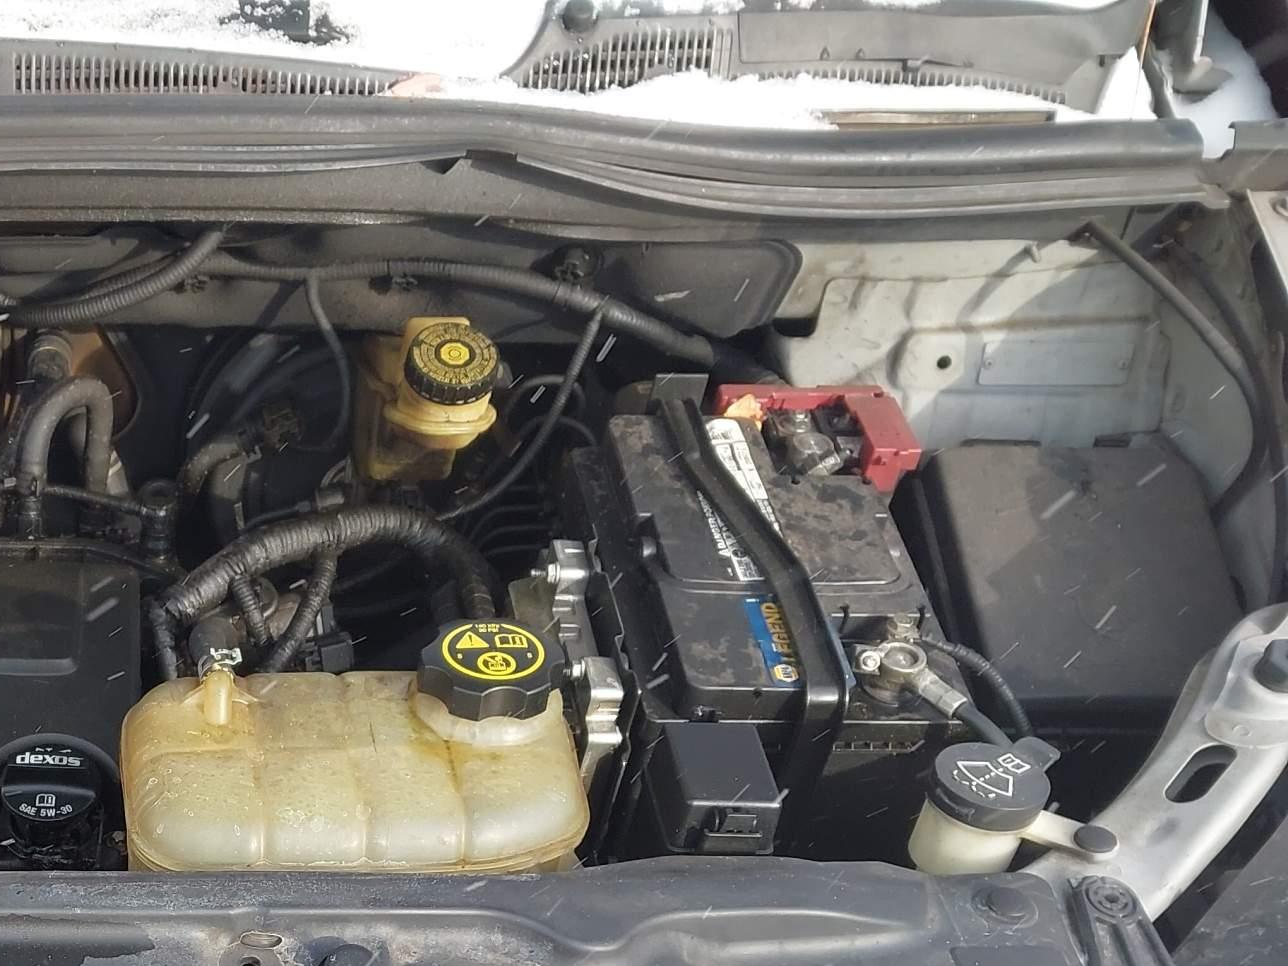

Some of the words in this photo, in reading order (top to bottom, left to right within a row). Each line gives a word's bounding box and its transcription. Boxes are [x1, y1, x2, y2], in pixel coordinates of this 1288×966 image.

[15, 752, 84, 767] dexos
[19, 803, 38, 816] SAE
[40, 804, 73, 817] 5W-30
